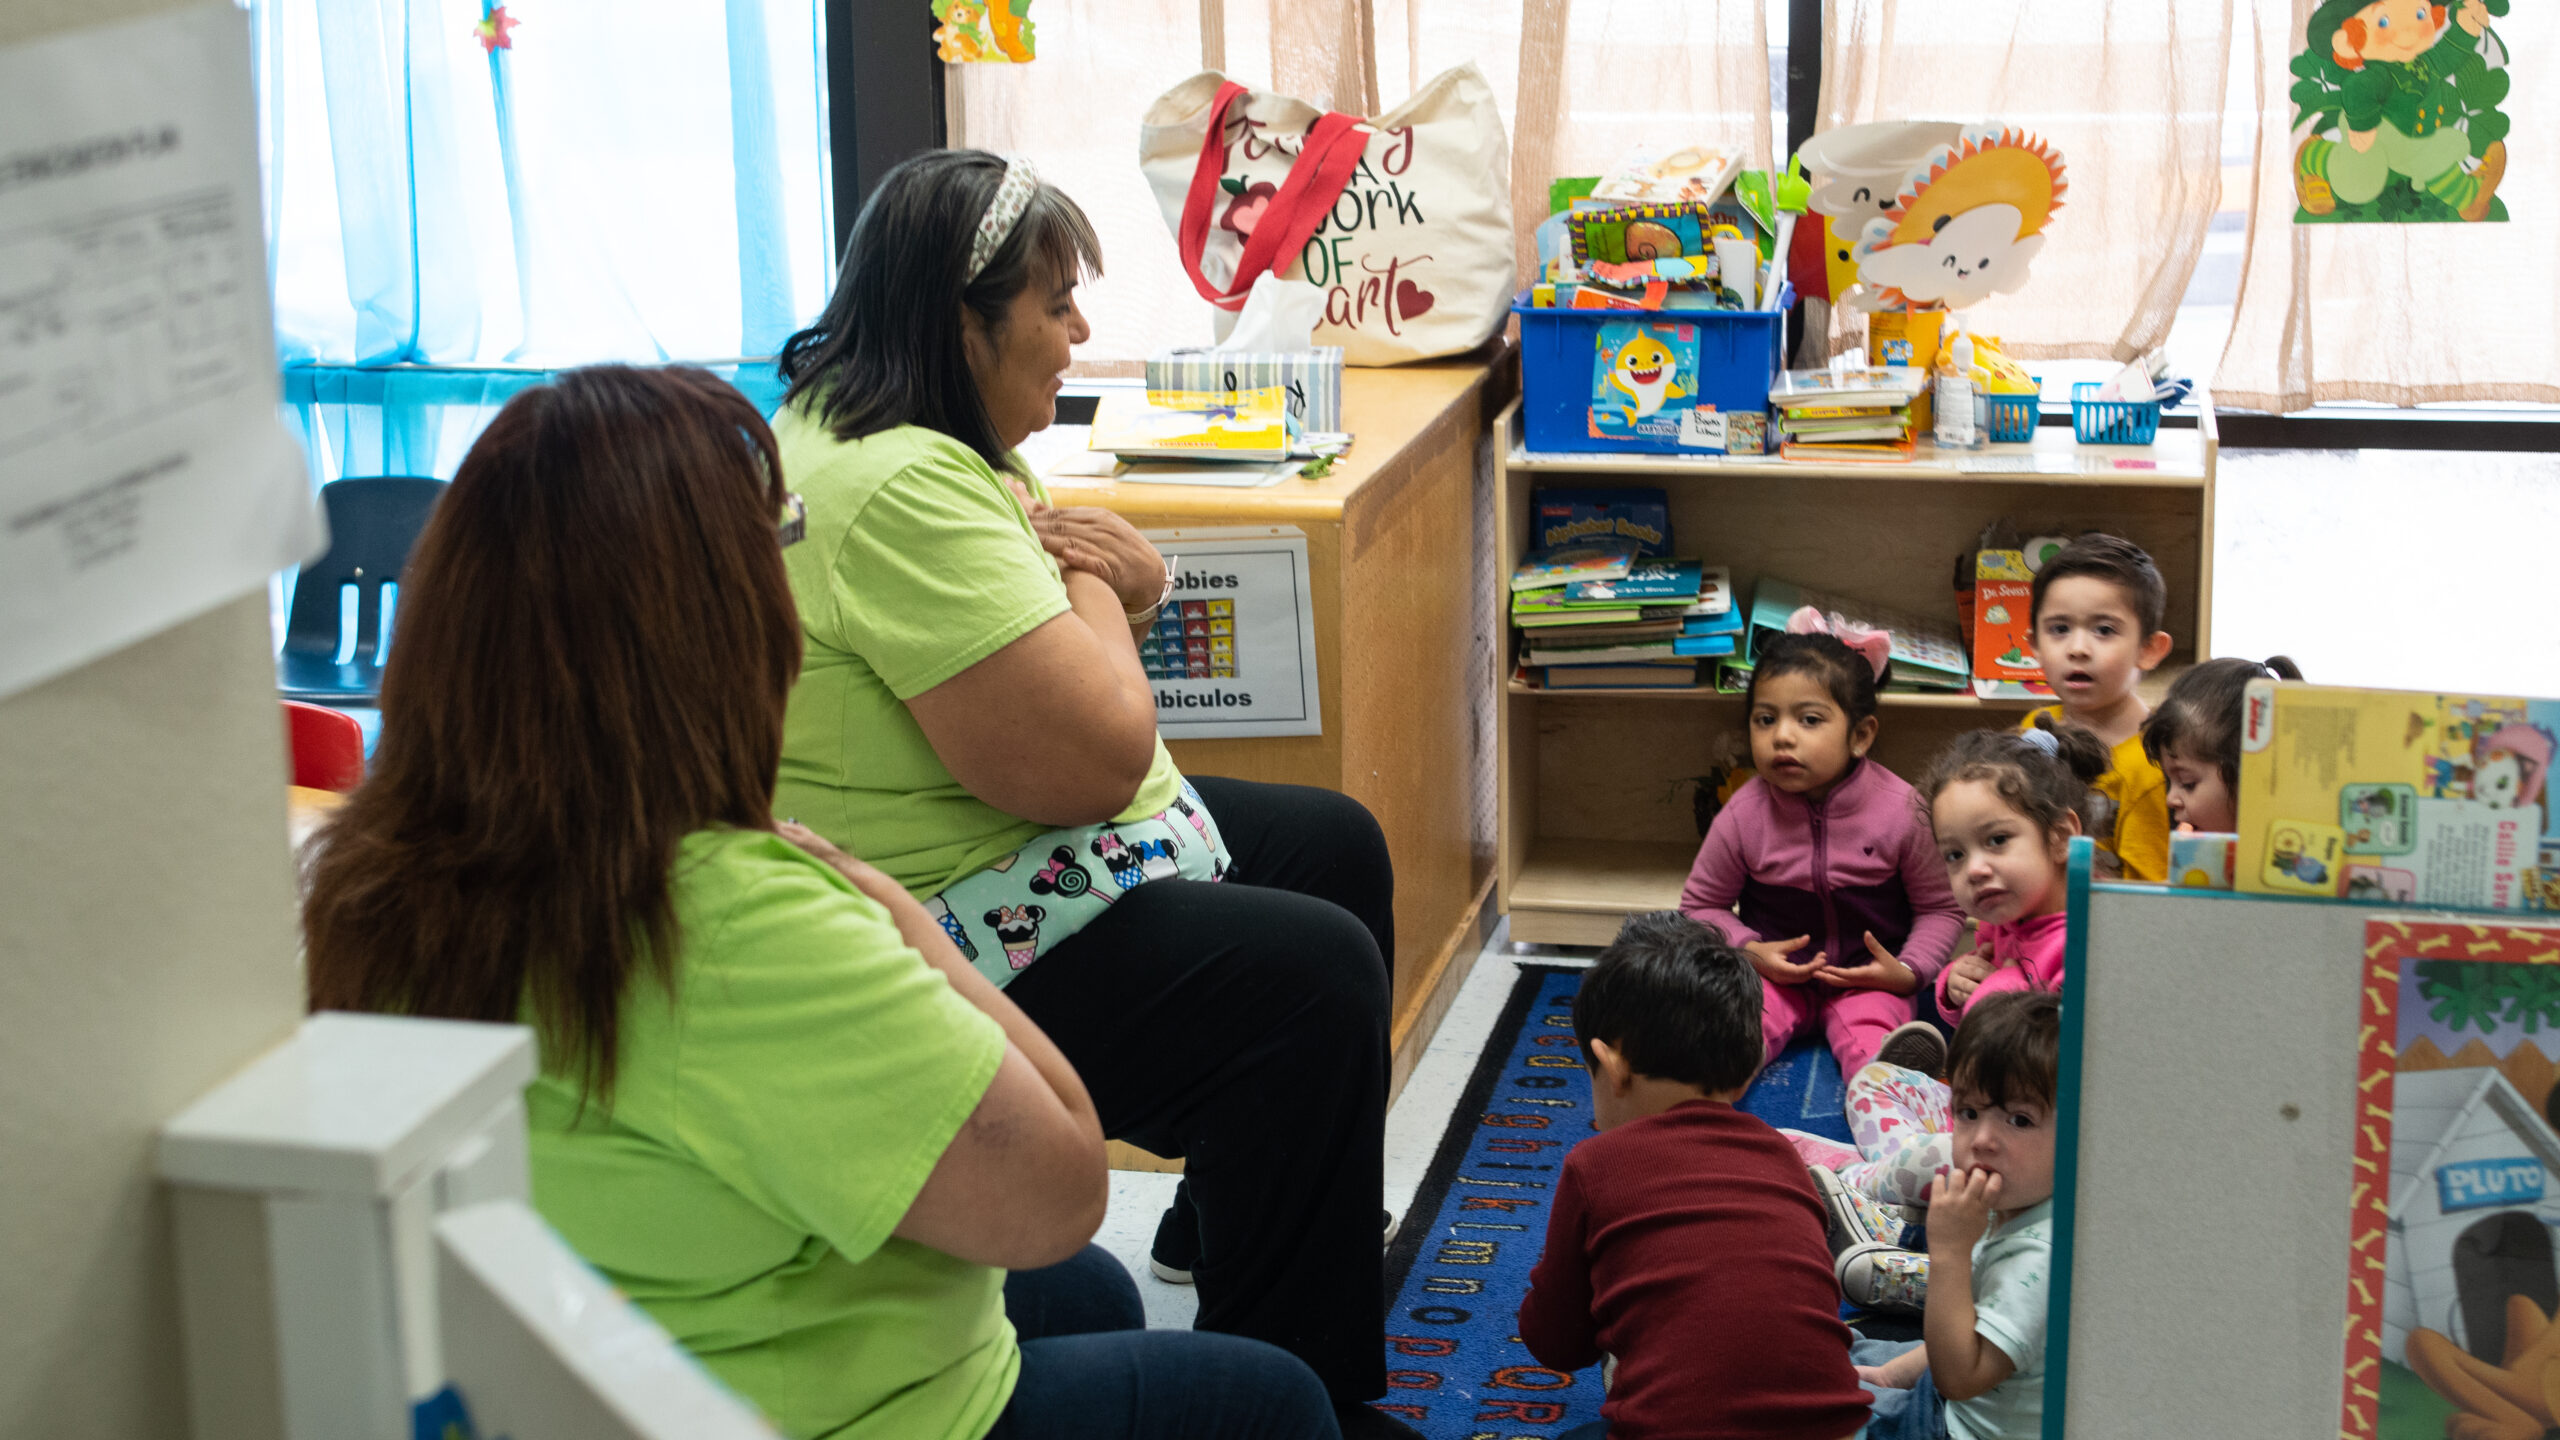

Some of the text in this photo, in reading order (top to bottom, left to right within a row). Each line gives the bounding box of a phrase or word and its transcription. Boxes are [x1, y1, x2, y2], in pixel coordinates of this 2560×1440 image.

[1314, 181, 1425, 235] ork
[1302, 236, 1353, 287] OF
[1312, 254, 1434, 337] art
[1154, 688, 1252, 708] biculos
[2449, 1166, 2541, 1201] PLUTO
[1433, 1239, 1500, 1264] m
[1480, 1365, 1575, 1391] Q
[1474, 1399, 1567, 1424] R
